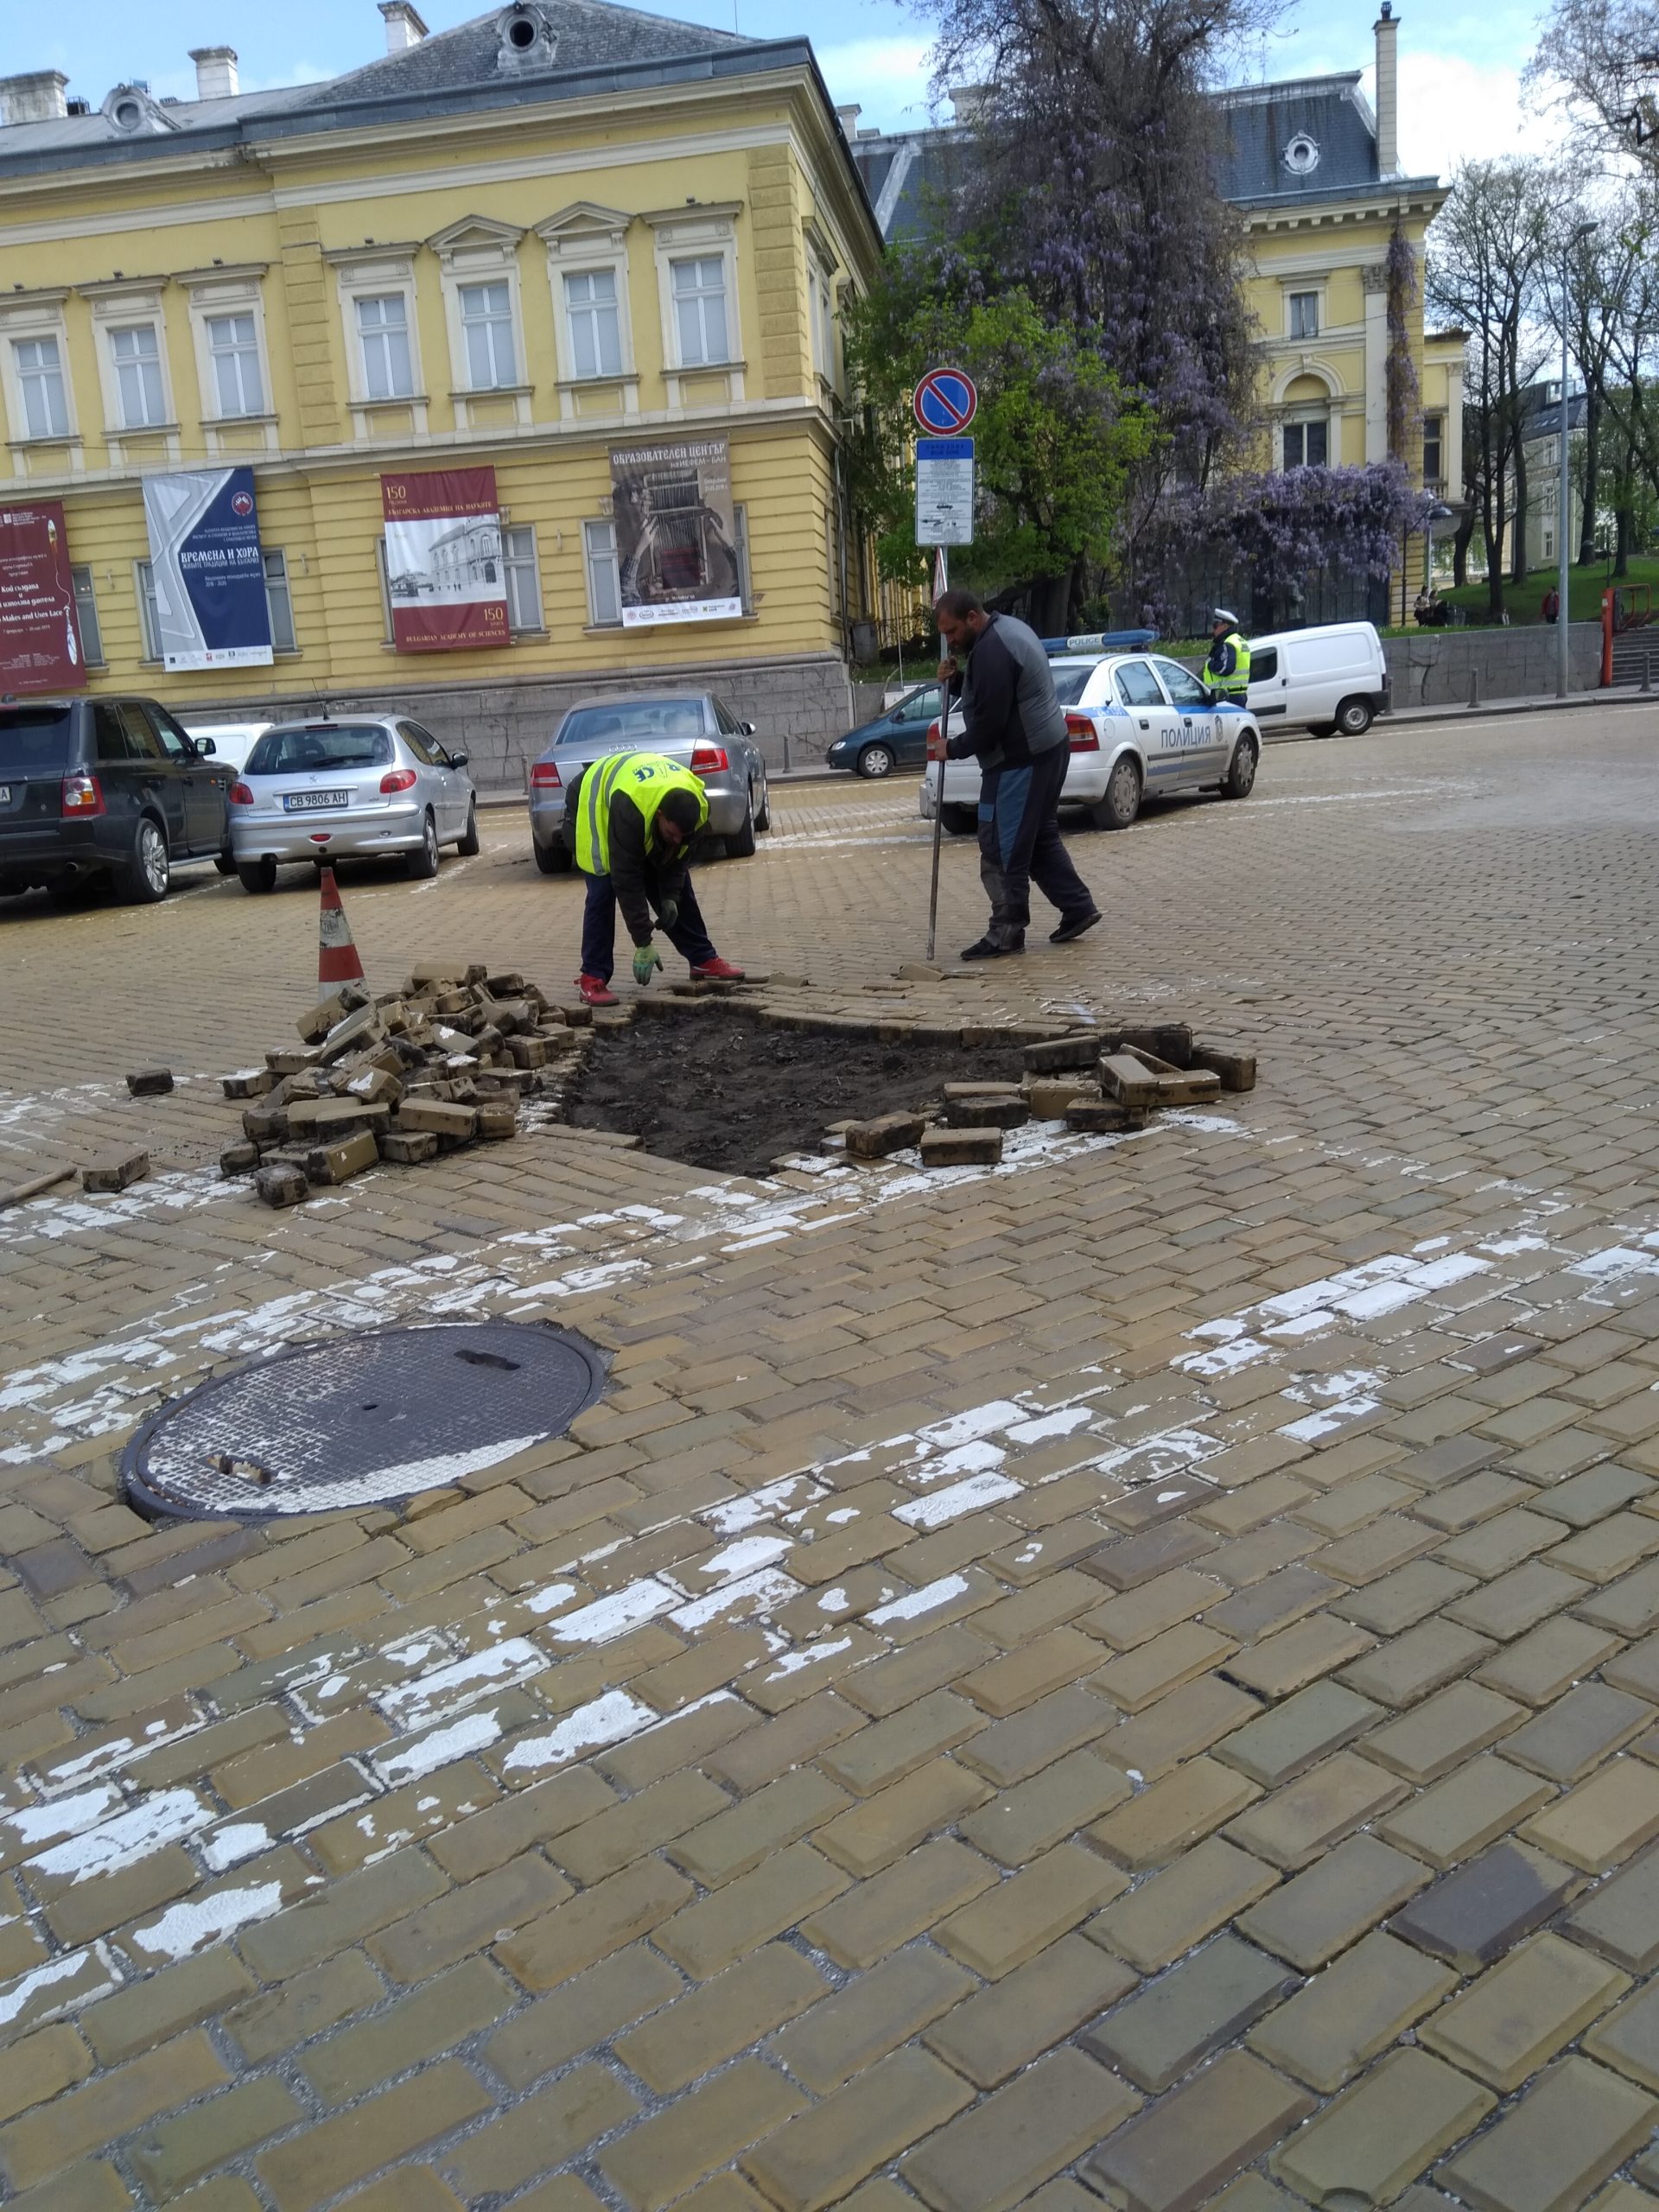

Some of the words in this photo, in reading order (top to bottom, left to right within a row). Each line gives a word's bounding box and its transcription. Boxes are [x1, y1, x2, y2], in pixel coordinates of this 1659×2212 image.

[613, 447, 687, 465] ОБРАЗОВАТЕЛЕН
[689, 443, 725, 458] ЦЕНТЪР
[386, 485, 406, 499] 150
[181, 550, 226, 563] ВРЕМЕНА
[227, 549, 234, 560] И
[236, 546, 259, 558] ХОРА
[1, 585, 14, 594] Кой
[2, 613, 22, 622] Makes
[22, 612, 34, 620] and
[484, 607, 504, 621] 150
[406, 634, 437, 643] BULGARIAN
[440, 632, 467, 640] ACADEMY
[1069, 636, 1100, 645] POLICE
[1161, 725, 1211, 748] ПОЛИЦИЯ
[289, 798, 303, 807] CB
[306, 793, 330, 806] 9806
[333, 792, 346, 804] AH
